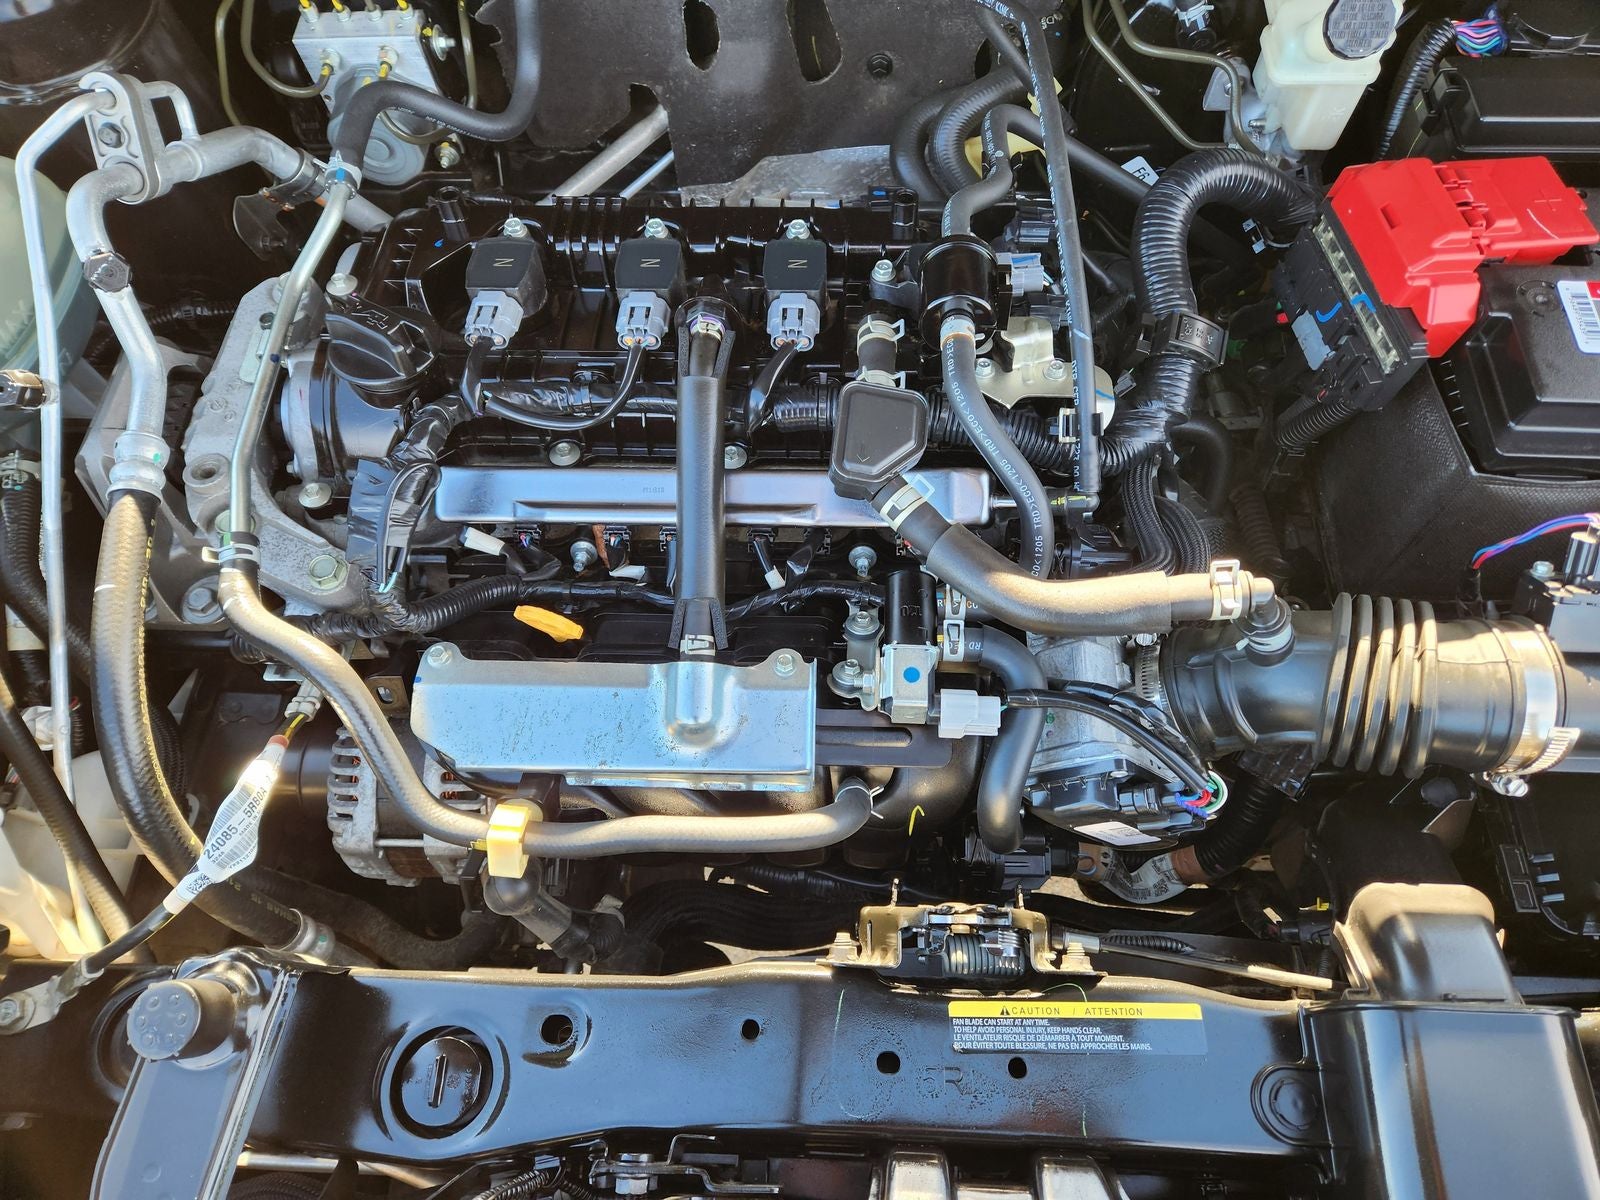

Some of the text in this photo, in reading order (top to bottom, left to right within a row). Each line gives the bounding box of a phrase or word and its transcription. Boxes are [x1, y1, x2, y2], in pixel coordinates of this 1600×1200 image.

[1011, 1006, 1061, 1016] CAUTION
[1084, 1007, 1143, 1016] ATTENTION
[997, 1018, 1014, 1026] START
[1025, 1026, 1047, 1034] INJURY,
[1003, 1034, 1025, 1042] RISQUE
[1036, 1033, 1070, 1042] DÉMARRER
[1015, 1042, 1047, 1050] BLESSURE,
